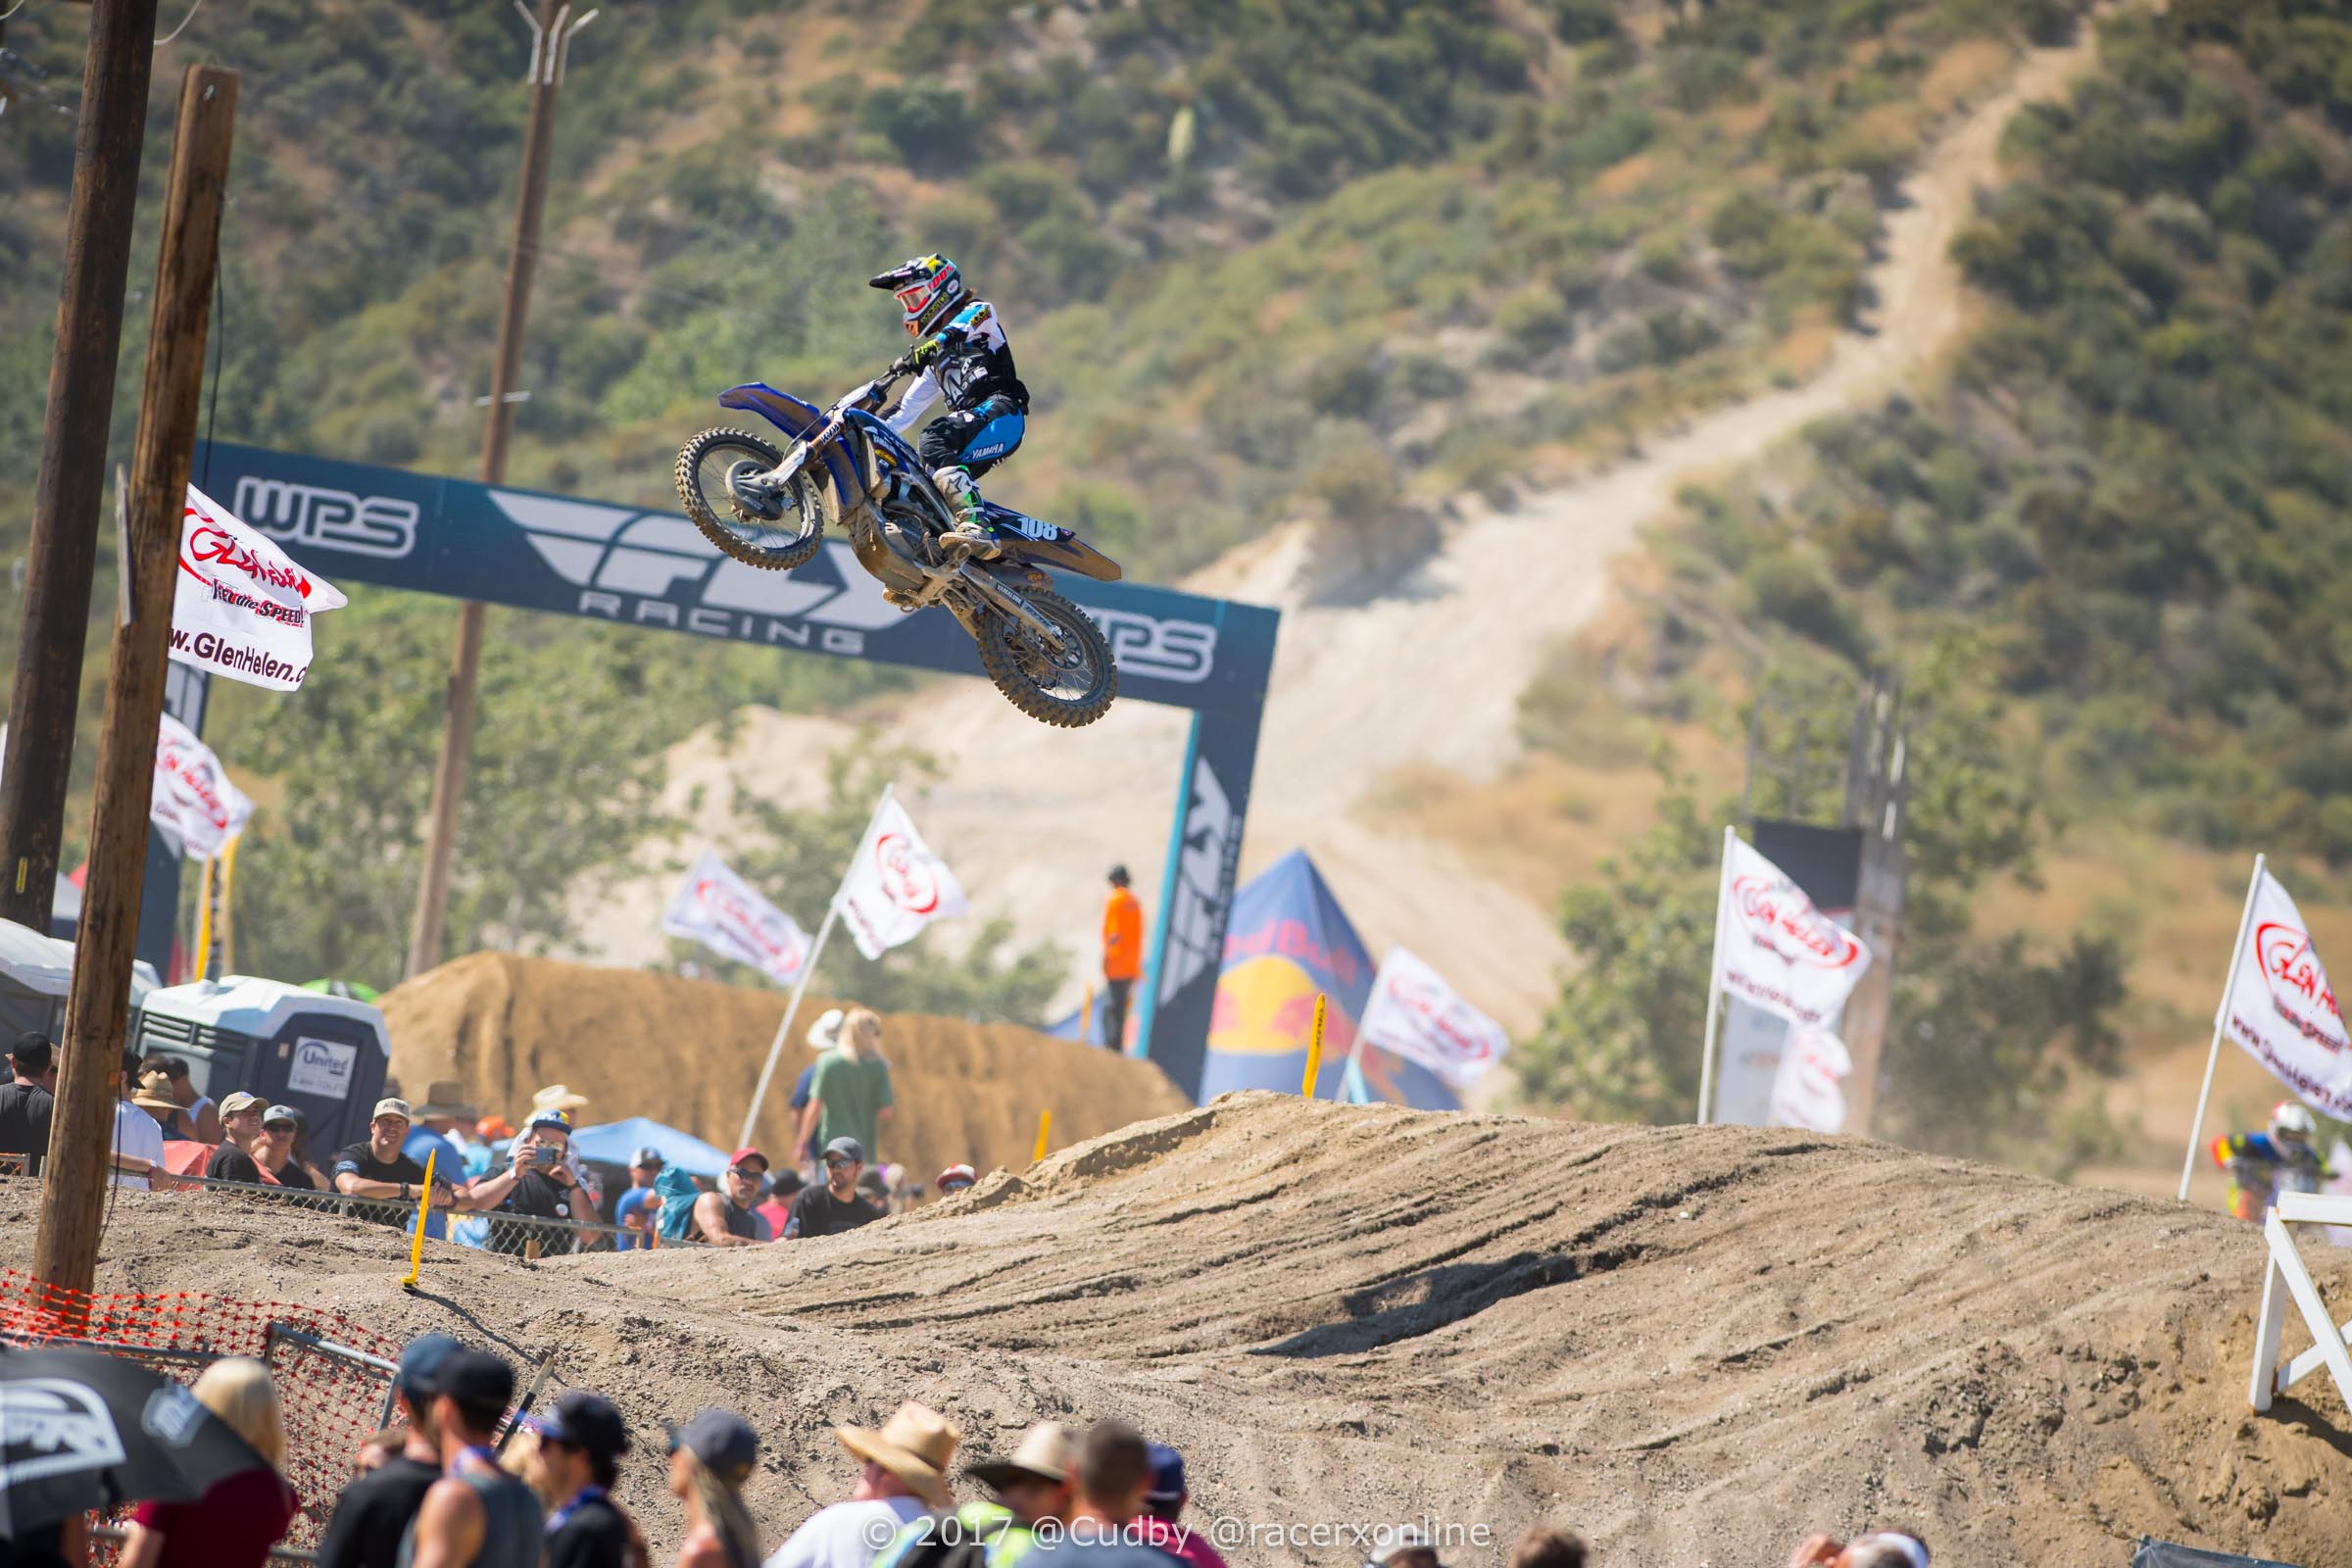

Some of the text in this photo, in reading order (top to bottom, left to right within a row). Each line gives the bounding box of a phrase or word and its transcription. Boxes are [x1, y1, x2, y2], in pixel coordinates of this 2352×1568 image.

[926, 263, 956, 292] 100%
[972, 443, 1004, 460] YAMAHA
[233, 476, 419, 559] WPS
[1017, 516, 1058, 541] 108
[579, 591, 864, 656] RACING
[1076, 604, 1217, 684] PS
